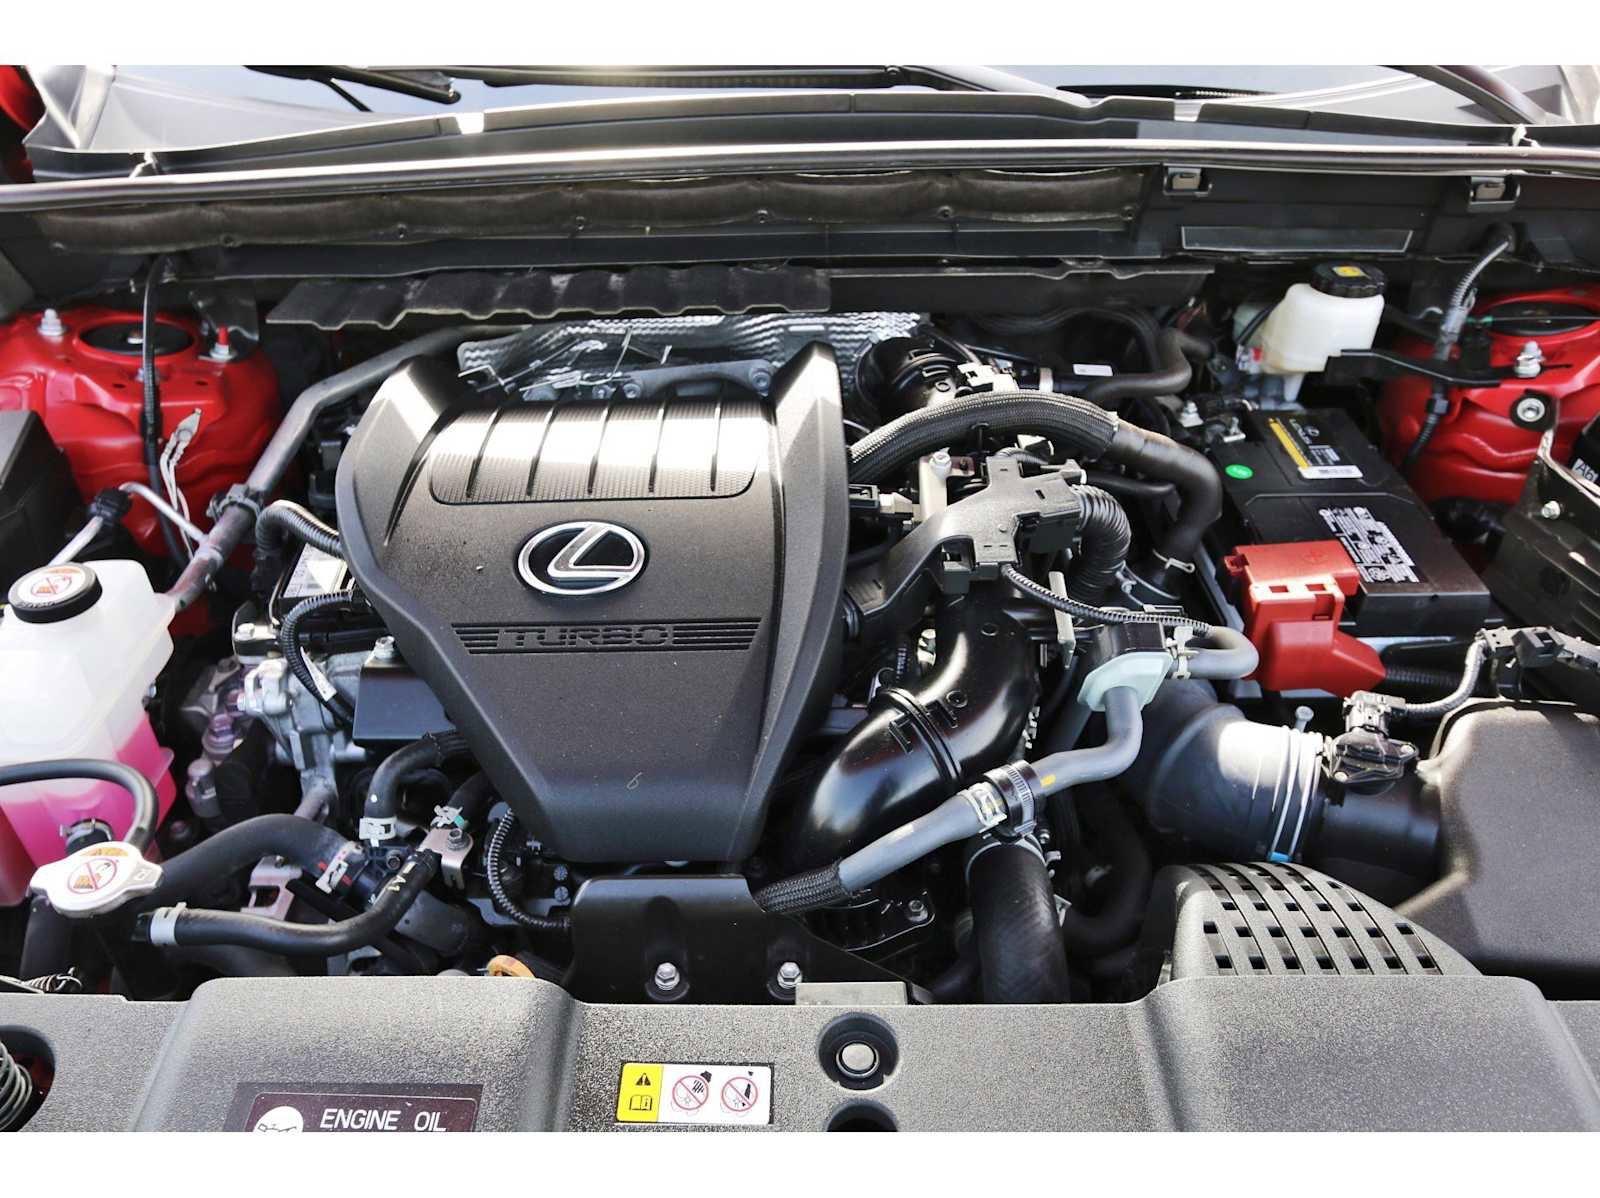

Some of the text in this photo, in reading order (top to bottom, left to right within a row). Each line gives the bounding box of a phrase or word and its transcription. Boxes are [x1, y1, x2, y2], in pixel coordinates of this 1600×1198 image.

[503, 625, 669, 648] TURBO
[319, 1108, 447, 1132] ENGINE OIL
